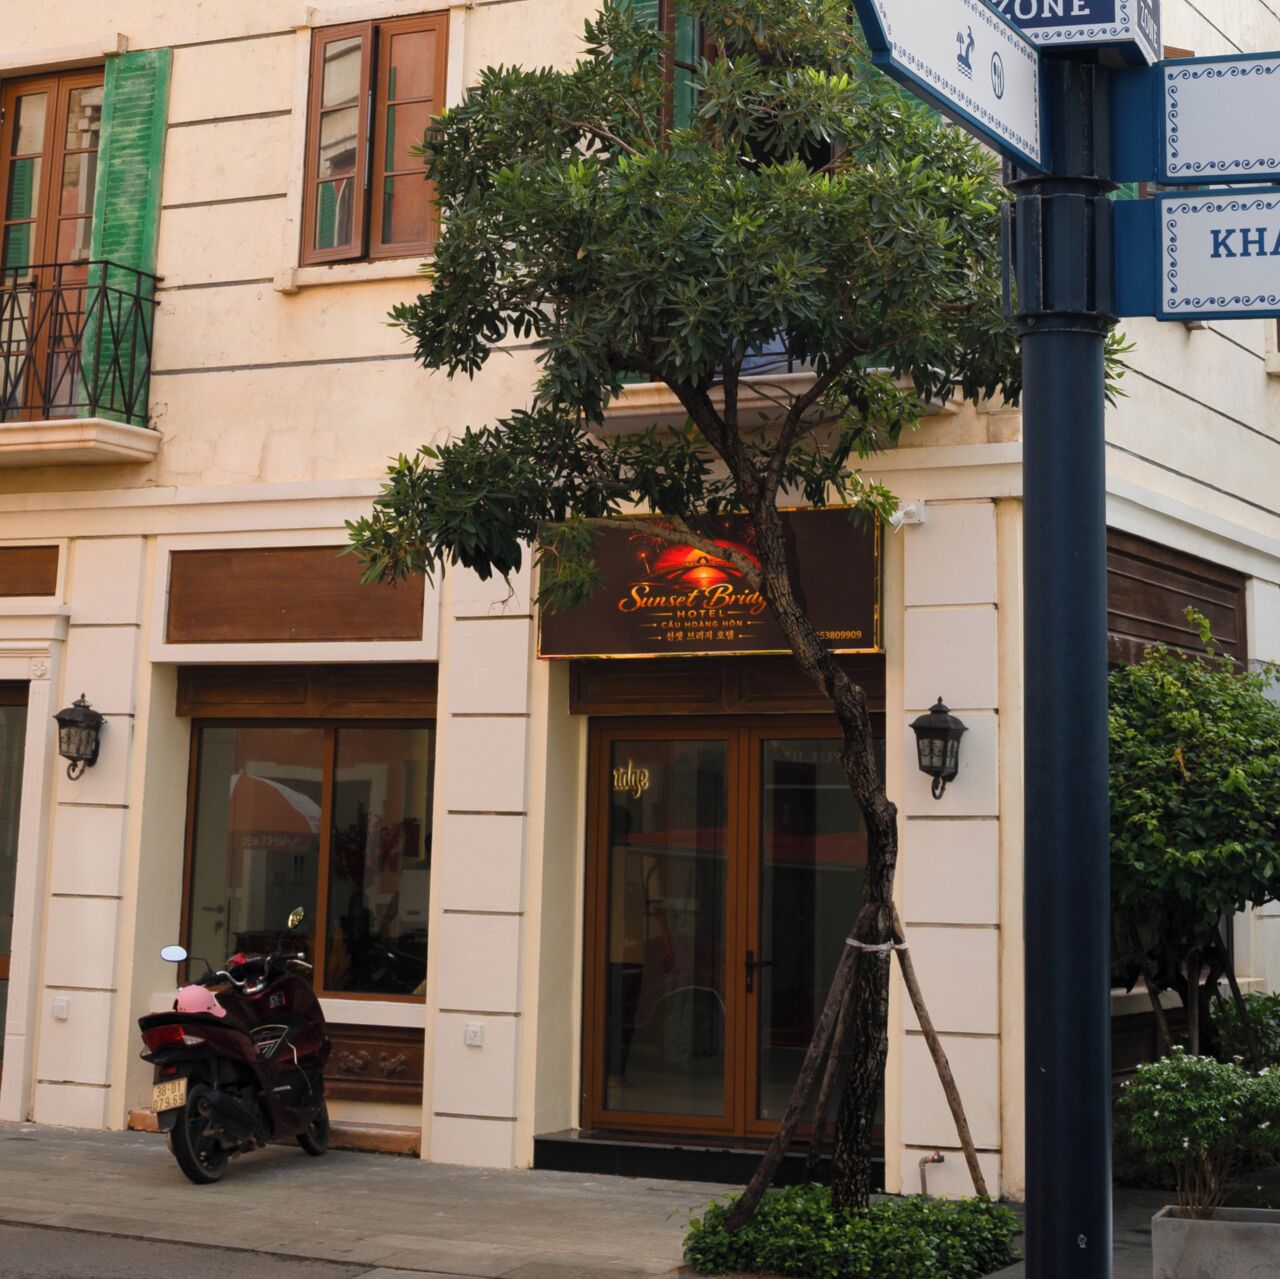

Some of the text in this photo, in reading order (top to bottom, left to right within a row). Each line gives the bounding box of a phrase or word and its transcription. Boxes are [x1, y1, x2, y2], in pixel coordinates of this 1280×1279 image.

[618, 583, 767, 615] Sunset Bridg
[677, 610, 725, 619] HOTEL
